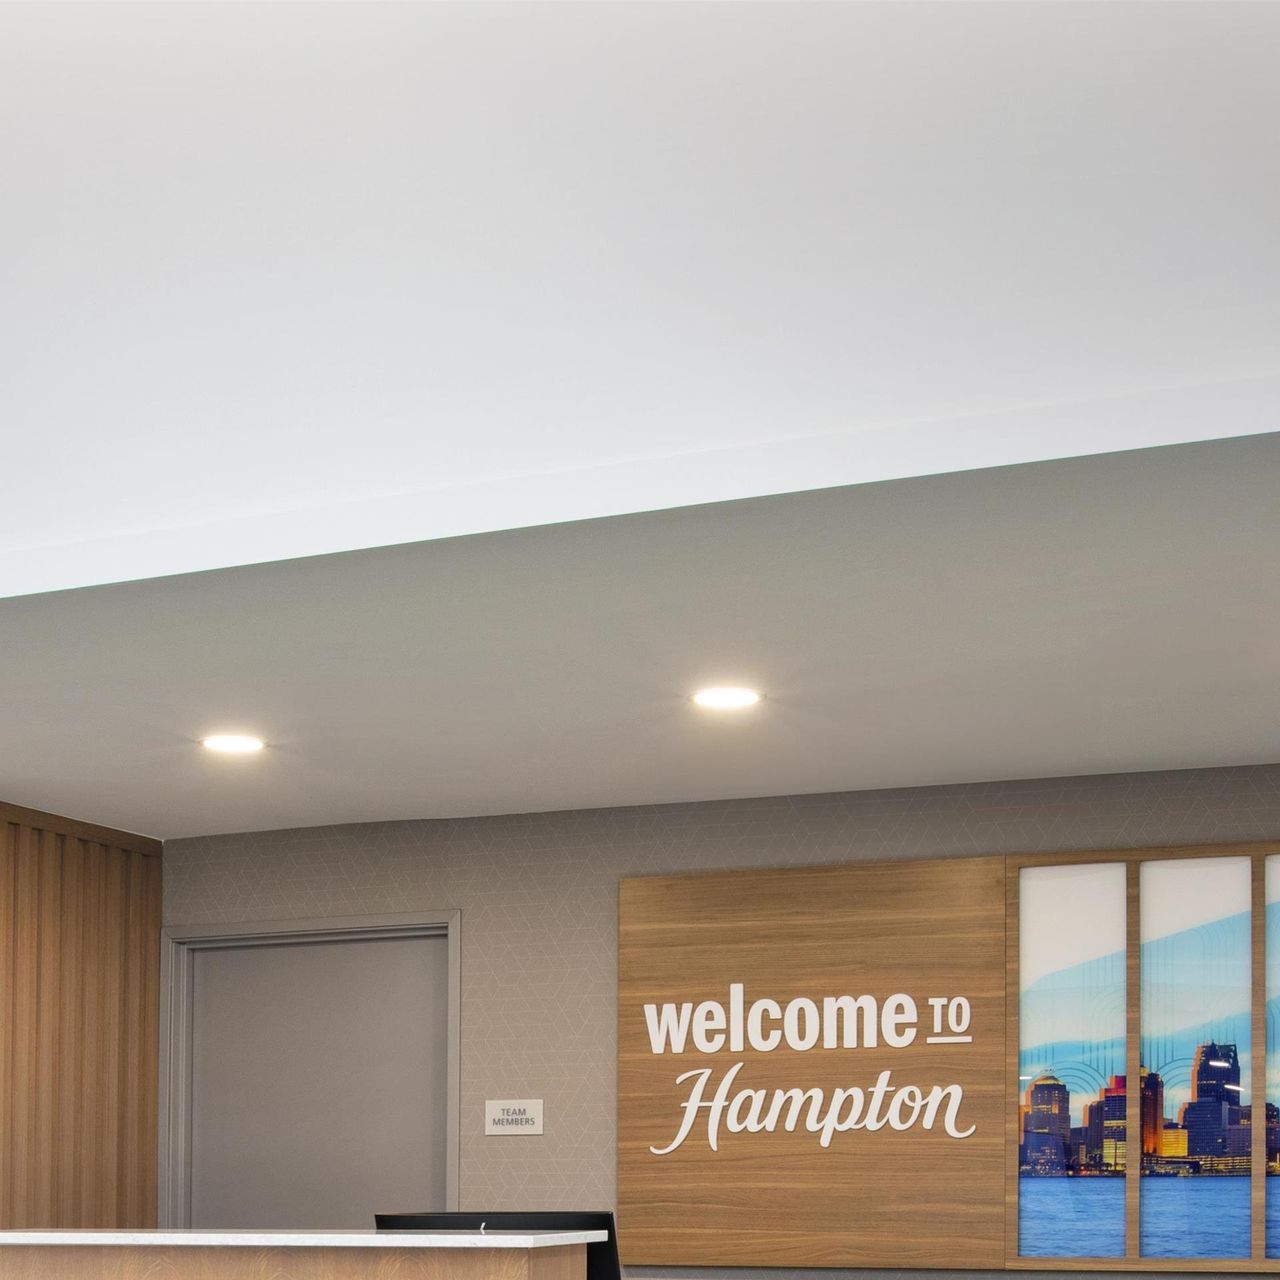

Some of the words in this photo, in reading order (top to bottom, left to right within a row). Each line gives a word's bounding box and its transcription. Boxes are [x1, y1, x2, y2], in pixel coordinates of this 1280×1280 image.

[643, 983, 918, 1055] welcome
[928, 996, 972, 1043] TO
[492, 1117, 536, 1127] MEMBERS
[501, 1108, 527, 1117] TEAM
[649, 1062, 976, 1155] Hampton
